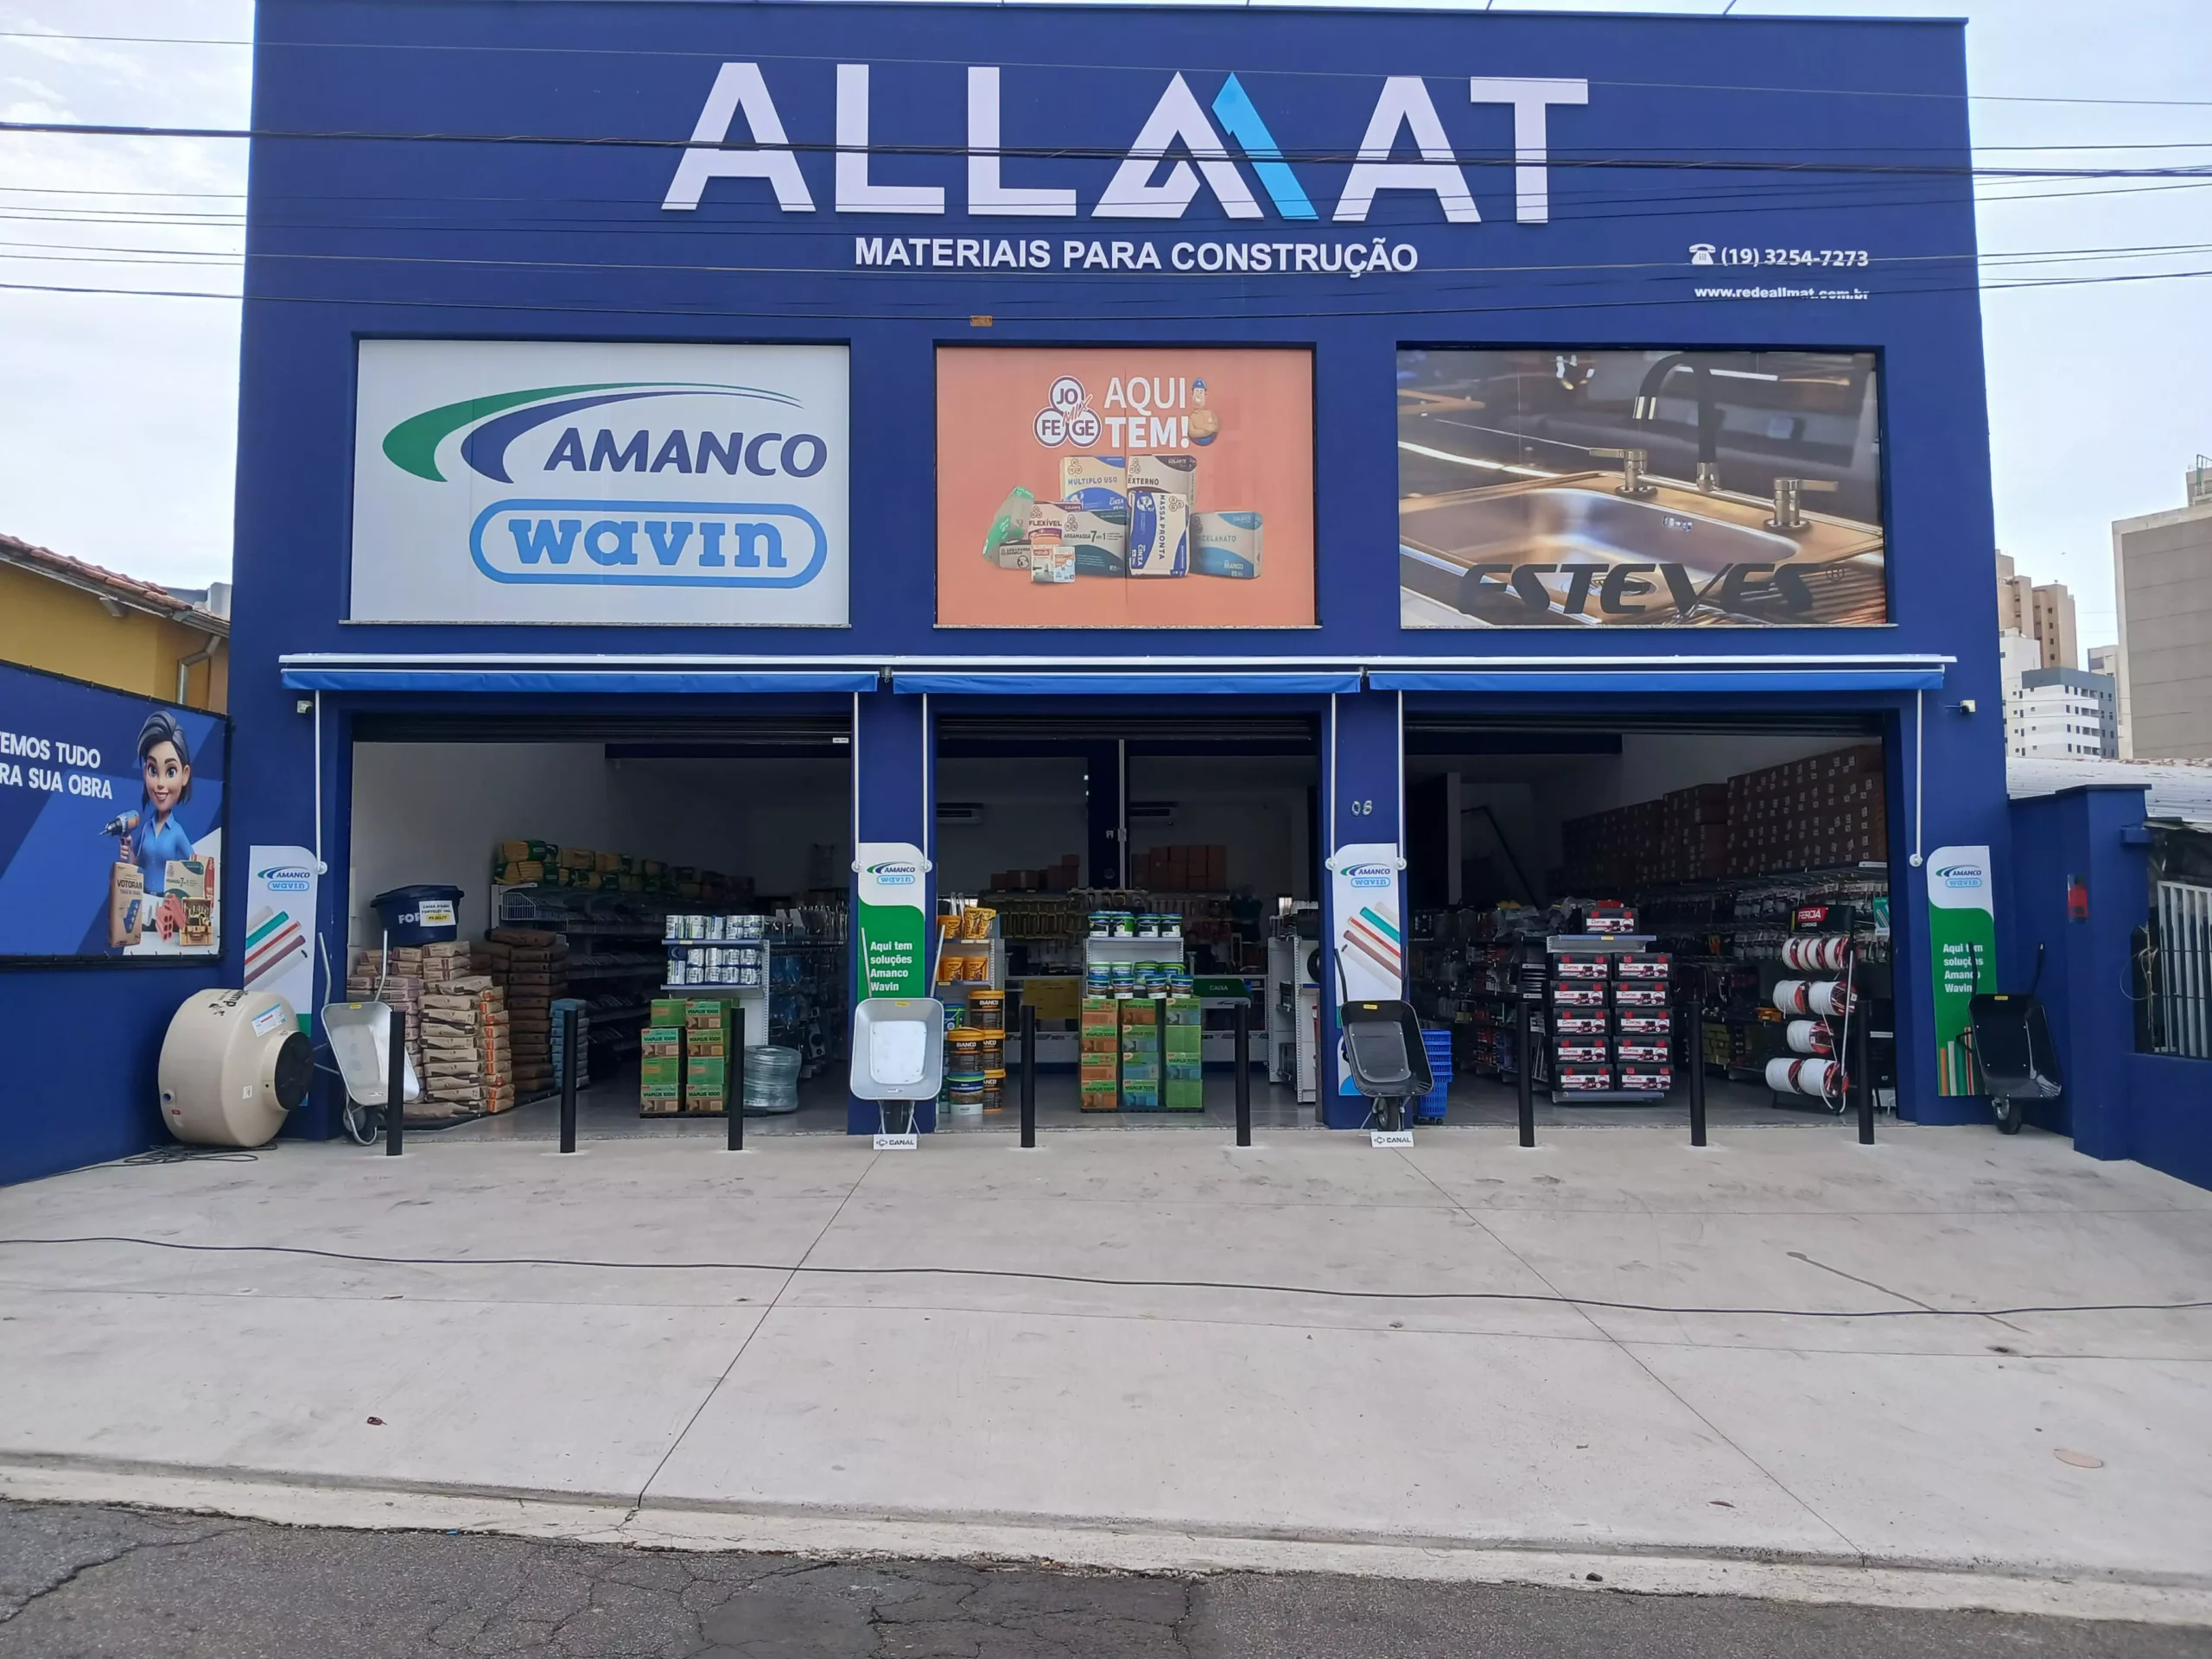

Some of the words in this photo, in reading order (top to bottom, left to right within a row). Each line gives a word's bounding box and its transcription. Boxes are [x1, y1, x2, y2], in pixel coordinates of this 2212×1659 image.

[661, 61, 1588, 223] ALLMAT
[855, 237, 1052, 270] MATERIAIS
[1063, 240, 1162, 270] PARA
[1171, 237, 1419, 278] CONSTRUÇÃO
[1721, 247, 1759, 268] (19)
[1764, 248, 1869, 267] 3254-7273
[1694, 286, 1870, 300] www.redeallmat.com.br
[1056, 388, 1078, 404] JO
[1103, 377, 1185, 416] AQUI
[1041, 420, 1061, 436] FE
[1071, 420, 1095, 436] GE
[1104, 416, 1190, 448] TEM!
[543, 427, 829, 478] AMANCO
[1128, 477, 1160, 486] EXTERNO
[508, 518, 788, 569] wavin
[1090, 531, 1097, 543] 7
[1455, 562, 1825, 615] ESTEVES
[0, 731, 50, 760] EMOS
[55, 741, 101, 769] TUDO
[29, 767, 64, 792] SUA
[68, 774, 113, 800] OBRA
[870, 941, 892, 952] Aqui
[894, 941, 912, 950] tem
[1943, 944, 1963, 954] Aqui
[1966, 944, 1983, 952] tm
[870, 954, 912, 966] soluções
[870, 969, 909, 977] Amanco
[870, 982, 899, 991] Wavin
[1945, 983, 1973, 993] Wavin
